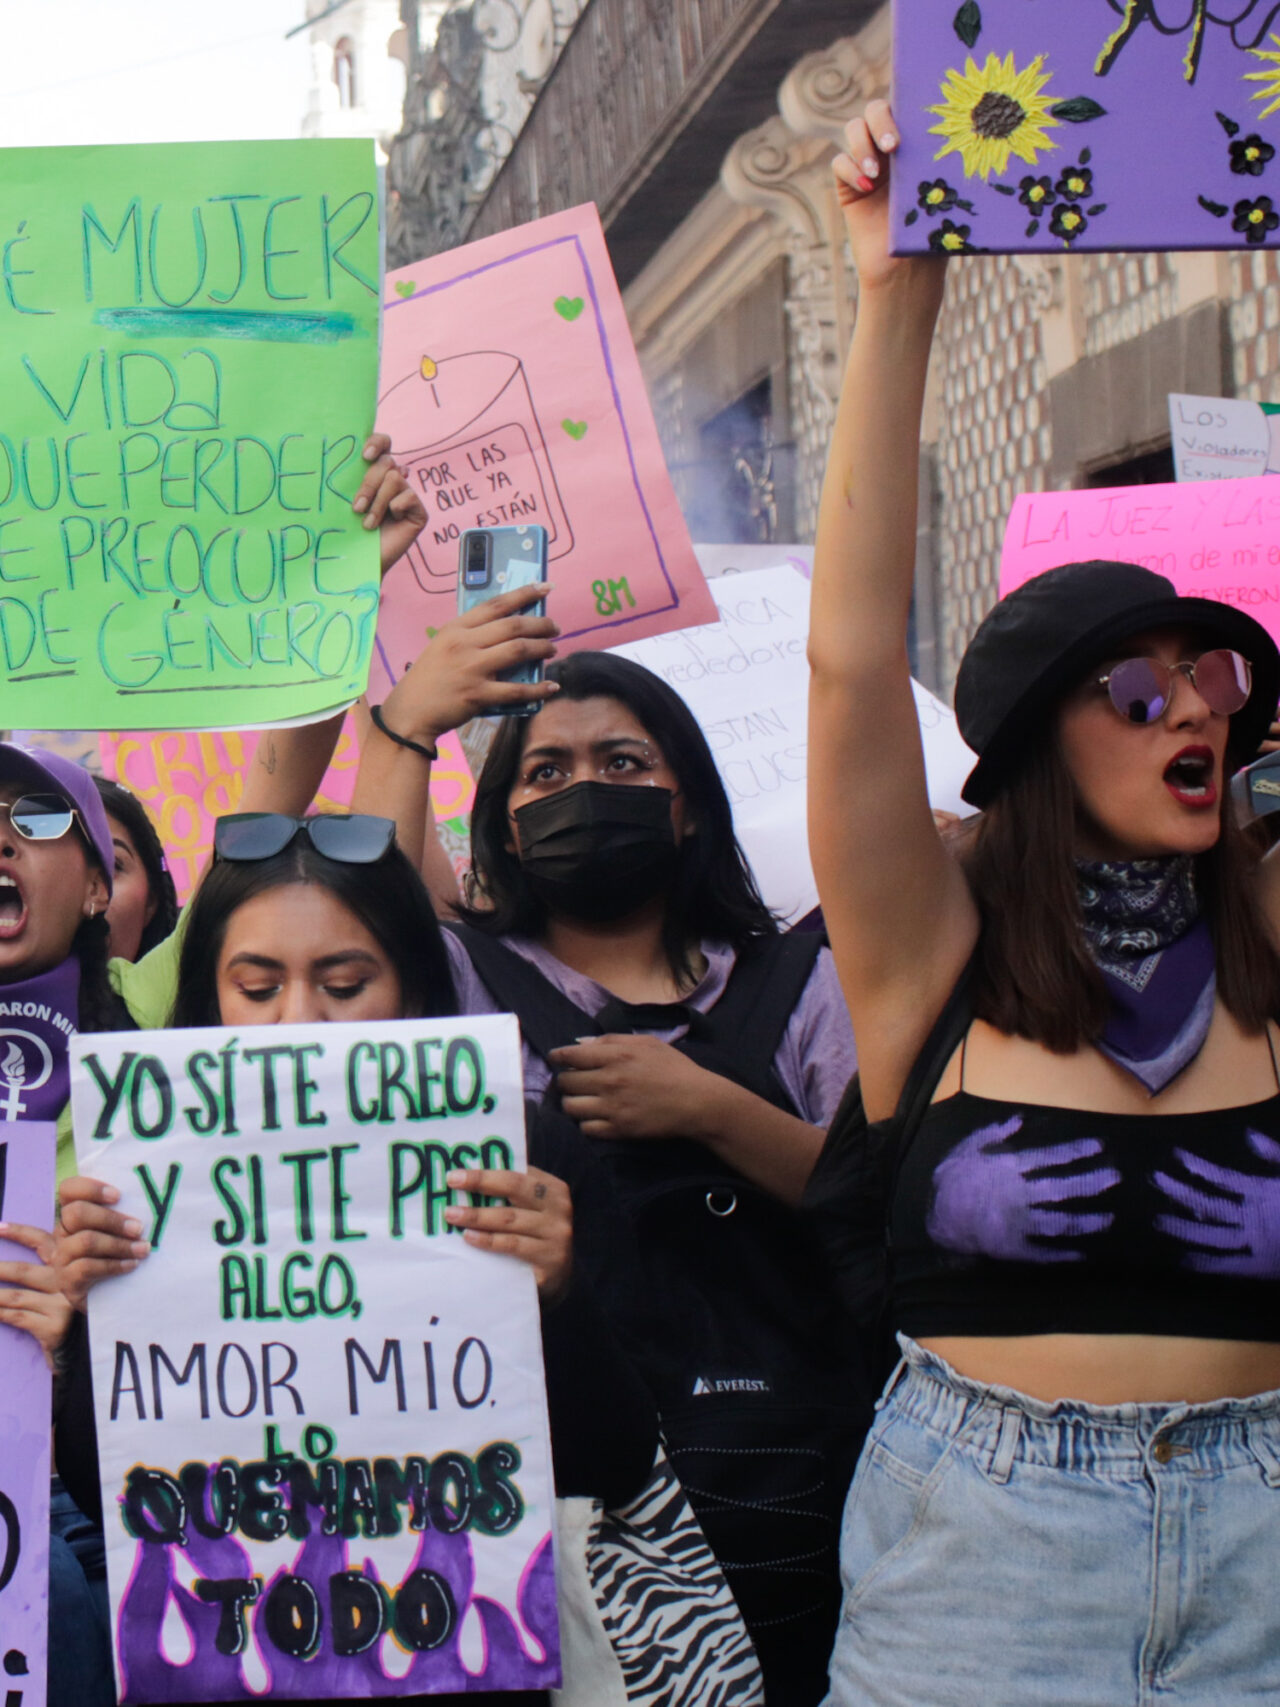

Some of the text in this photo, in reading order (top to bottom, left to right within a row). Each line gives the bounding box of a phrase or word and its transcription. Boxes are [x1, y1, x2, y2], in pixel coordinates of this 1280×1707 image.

[81, 194, 380, 308] MUJER
[118, 431, 357, 515] PERDER
[417, 443, 507, 493] POR LAS
[436, 471, 512, 512] QUE YA
[433, 523, 460, 544] NO
[1022, 503, 1071, 549] LA
[1088, 494, 1174, 538] JUEZ
[62, 516, 360, 605] PREOCUPE
[1190, 545, 1221, 571] de
[591, 576, 637, 616] 8M
[81, 1050, 178, 1142] YO
[346, 1034, 498, 1124] CREO,
[133, 1160, 181, 1250] Y
[220, 1251, 364, 1323] ALGO,
[109, 1339, 307, 1422] AMOR
[715, 1379, 765, 1392] EVEREST
[263, 1424, 337, 1462] LO
[122, 1438, 524, 1547] QUEMAMOS
[193, 1568, 459, 1659] TODO
